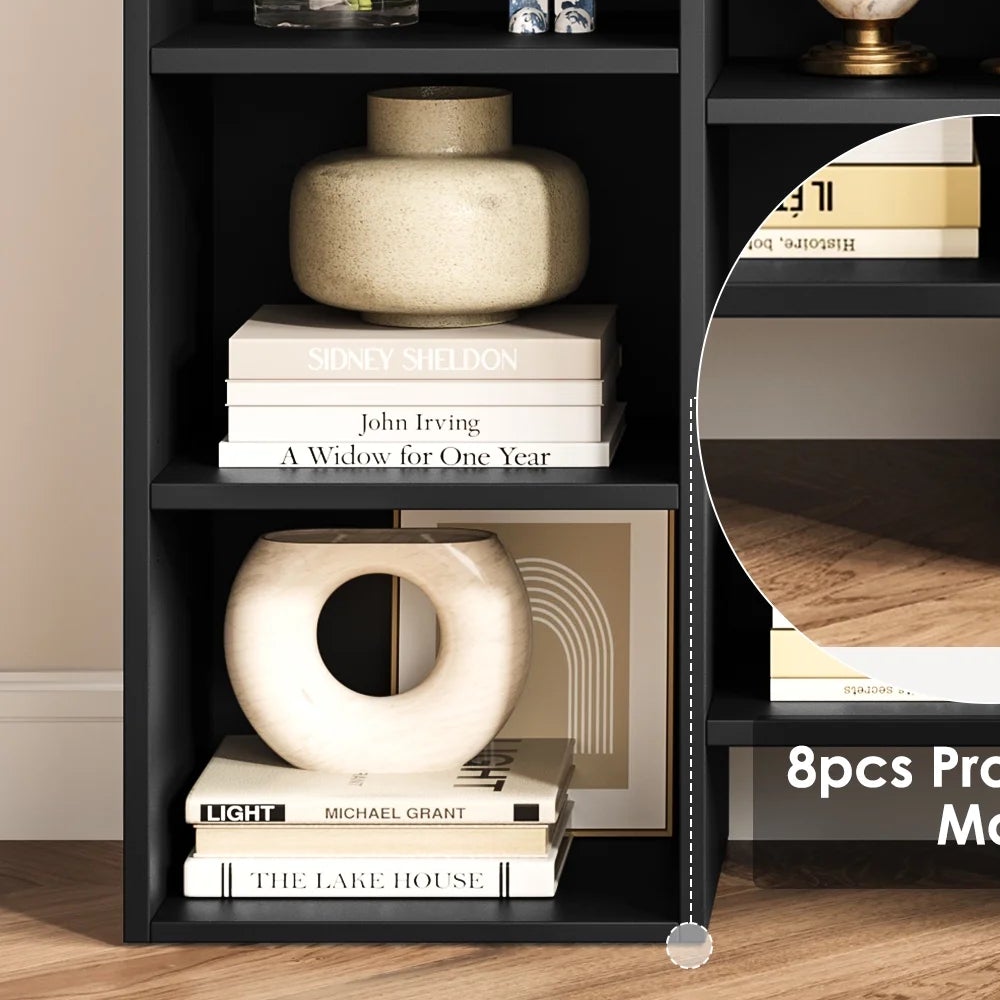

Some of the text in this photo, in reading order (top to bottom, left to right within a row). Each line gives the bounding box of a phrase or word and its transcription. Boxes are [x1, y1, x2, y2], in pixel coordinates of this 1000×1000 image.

[778, 236, 856, 252] Histoire,
[308, 346, 518, 372] SIDNEY SHELDON
[358, 412, 481, 436] John Irving
[280, 445, 551, 467] A Widow for One Year
[844, 686, 893, 695] secrets
[206, 805, 466, 822] LIGHT MICHAEL GRANT
[250, 872, 484, 889] THE LAKE HOUSE
